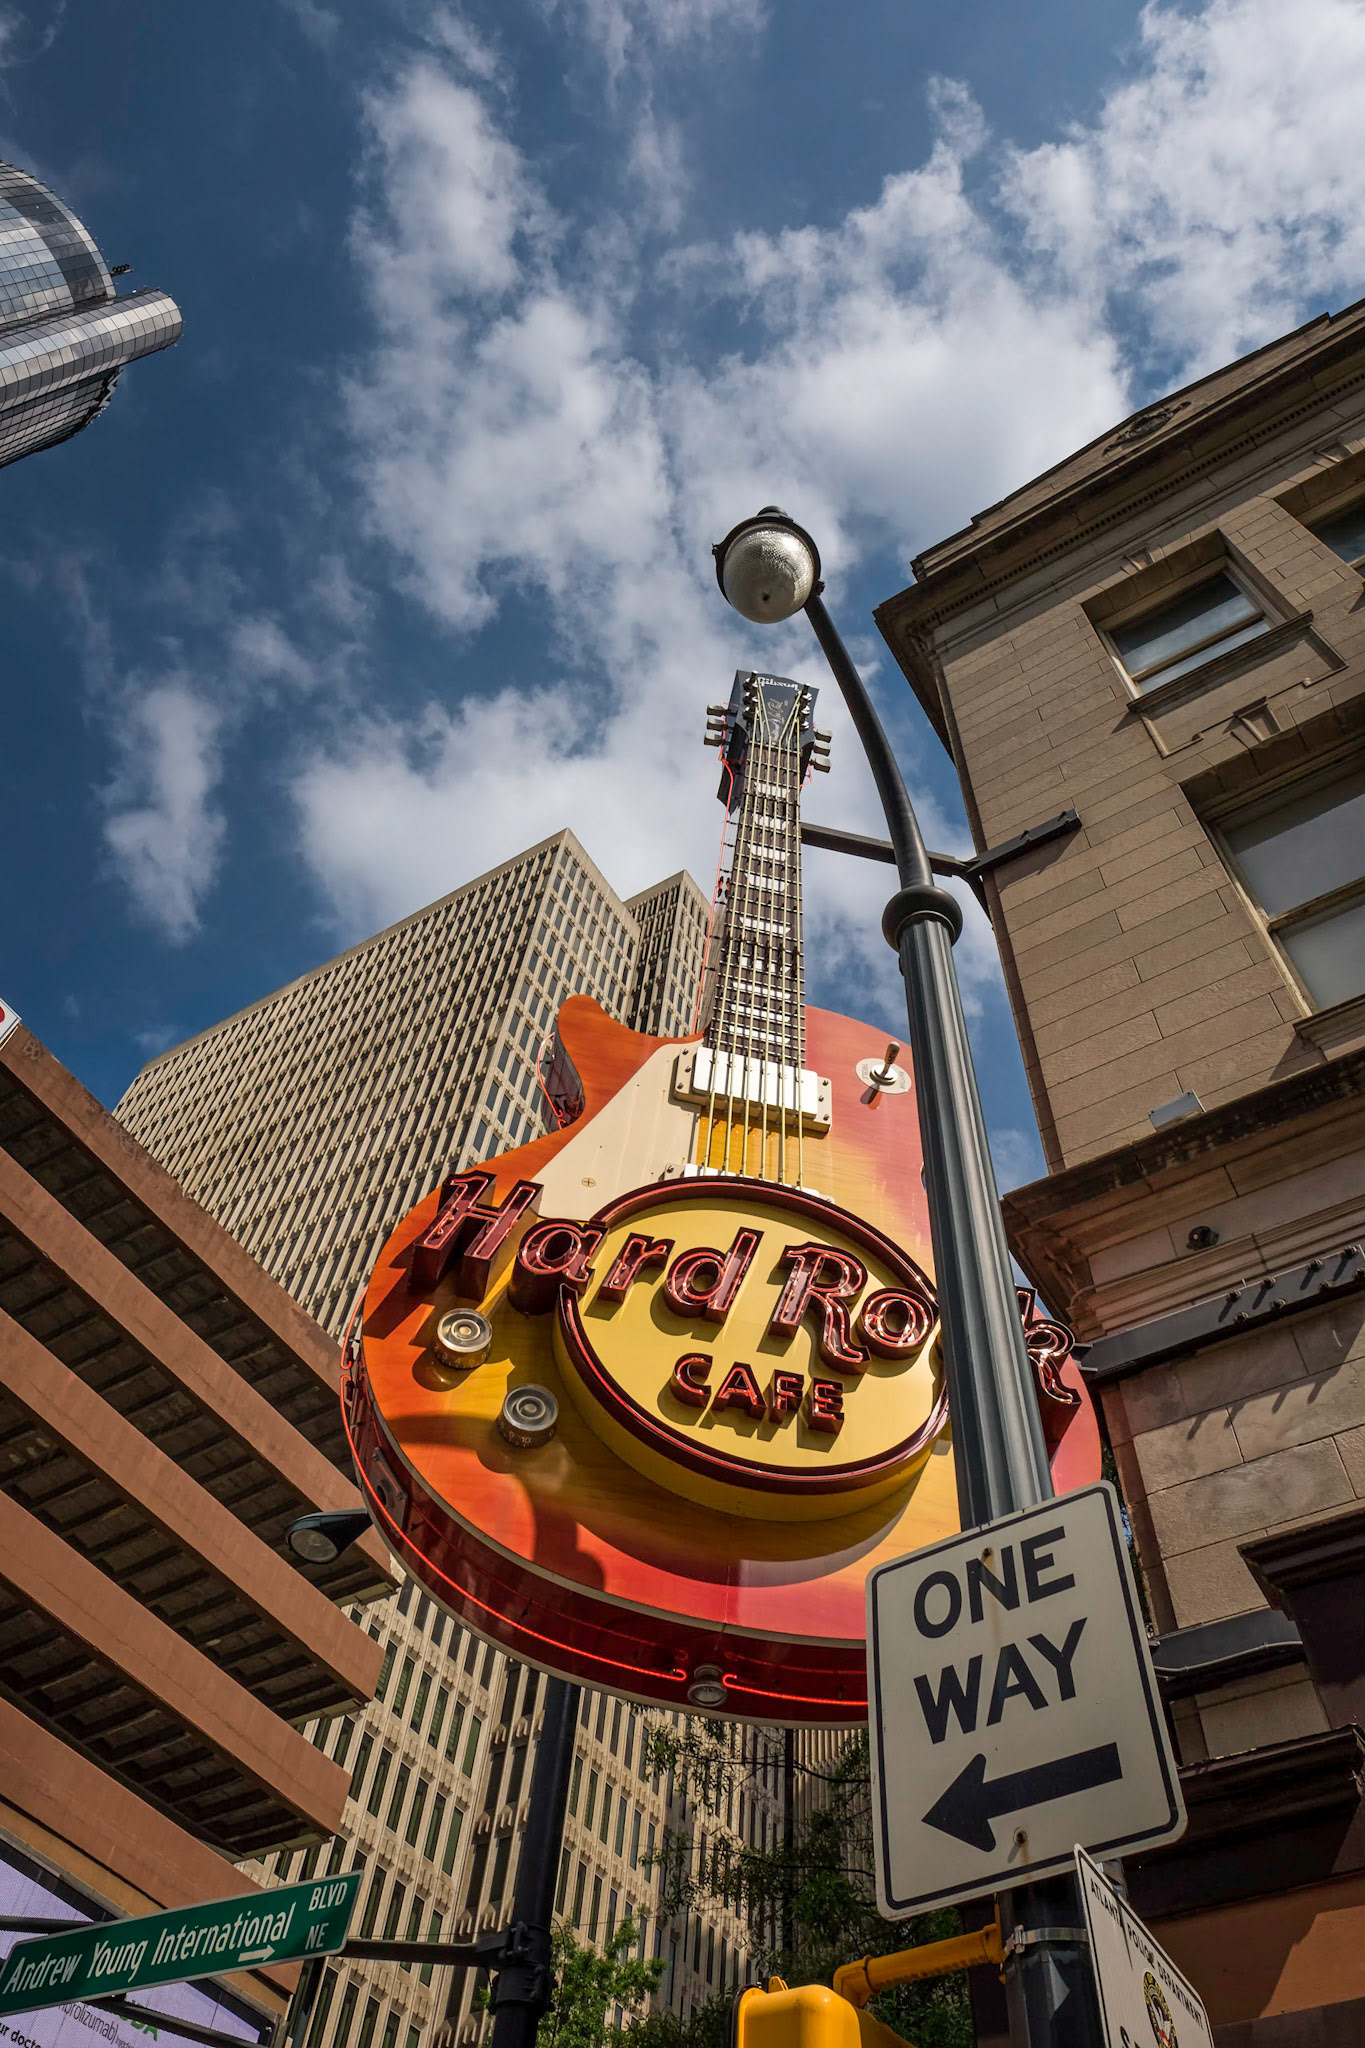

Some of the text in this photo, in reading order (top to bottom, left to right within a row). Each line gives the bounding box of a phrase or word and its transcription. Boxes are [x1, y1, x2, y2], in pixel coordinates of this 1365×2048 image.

[758, 677, 799, 691] Gibson
[412, 1170, 1083, 1405] Hard Rok
[672, 1353, 844, 1434] CAFE
[913, 1525, 1076, 1639] ONE
[913, 1616, 1088, 1746] WAY
[2, 1881, 348, 1995] Andrew Young International BLVD
[304, 1922, 330, 1951] NE
[1157, 1960, 1204, 2030] DEPARTMENT
